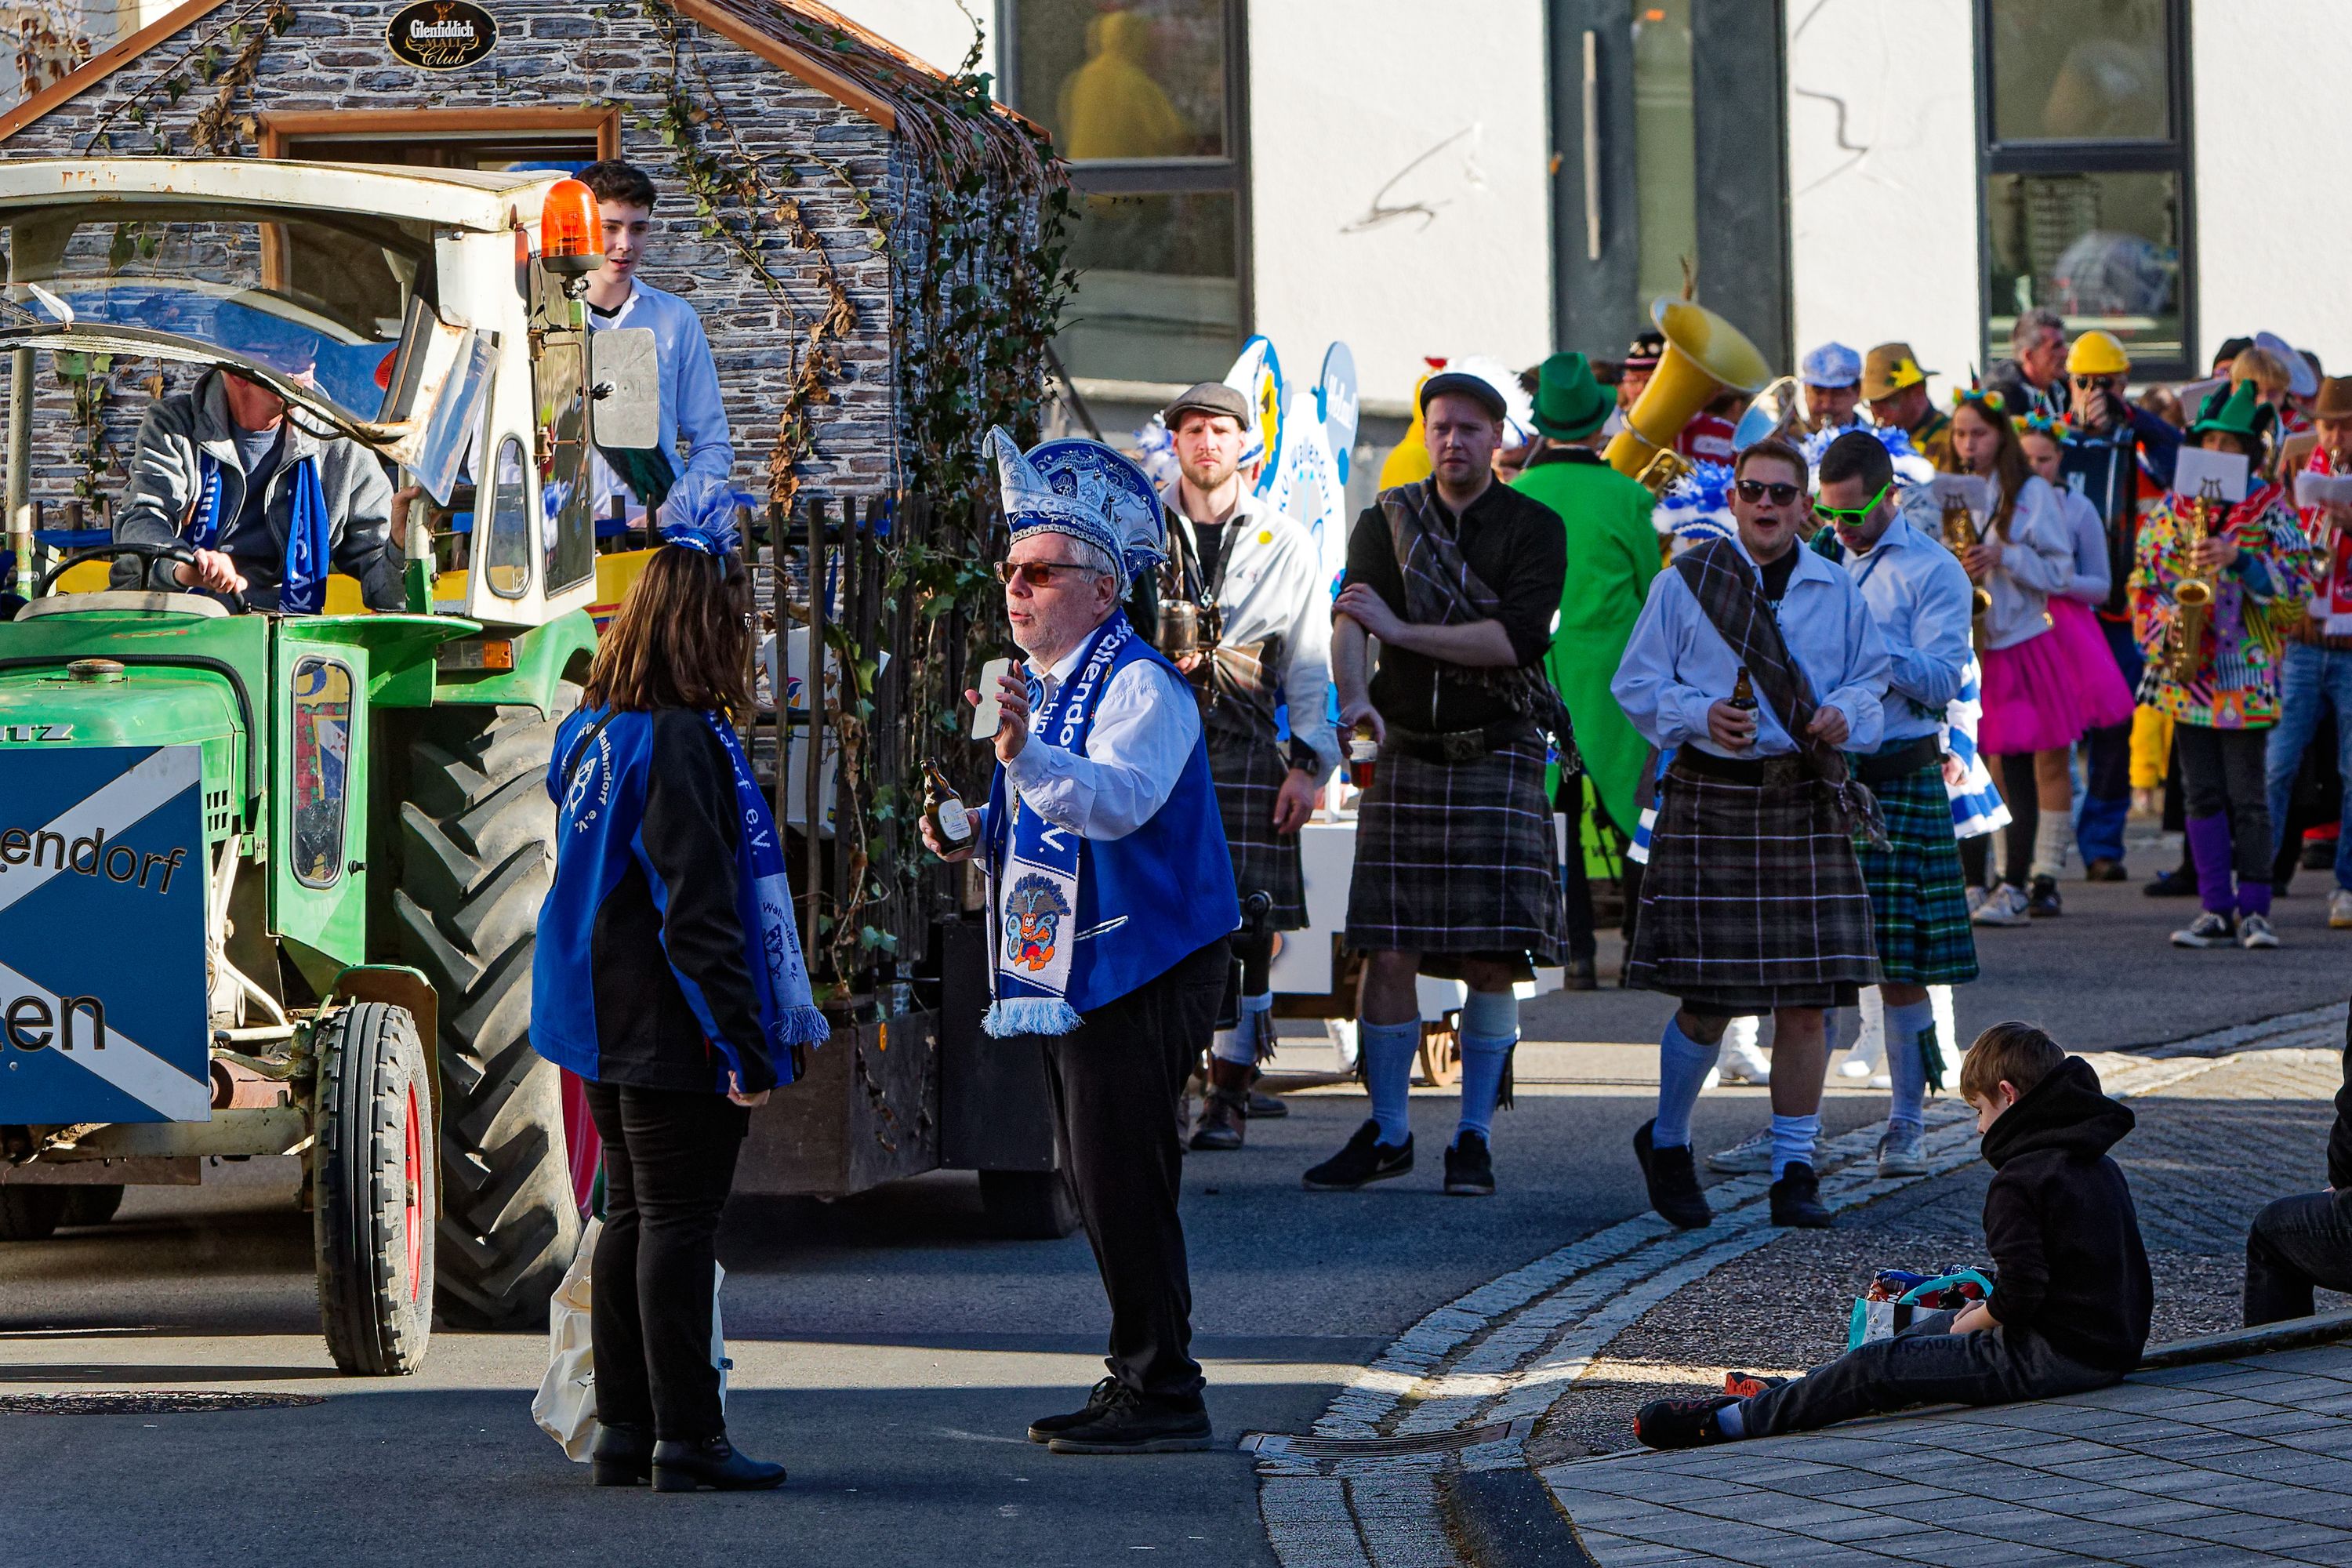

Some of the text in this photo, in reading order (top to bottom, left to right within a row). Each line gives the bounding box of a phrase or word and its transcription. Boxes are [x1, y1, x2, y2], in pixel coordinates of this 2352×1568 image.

[410, 19, 474, 38] Glenfiddich
[424, 38, 463, 48] MALT
[419, 45, 466, 66] Club
[746, 808, 771, 856] e.V.
[0, 994, 105, 1052] en
